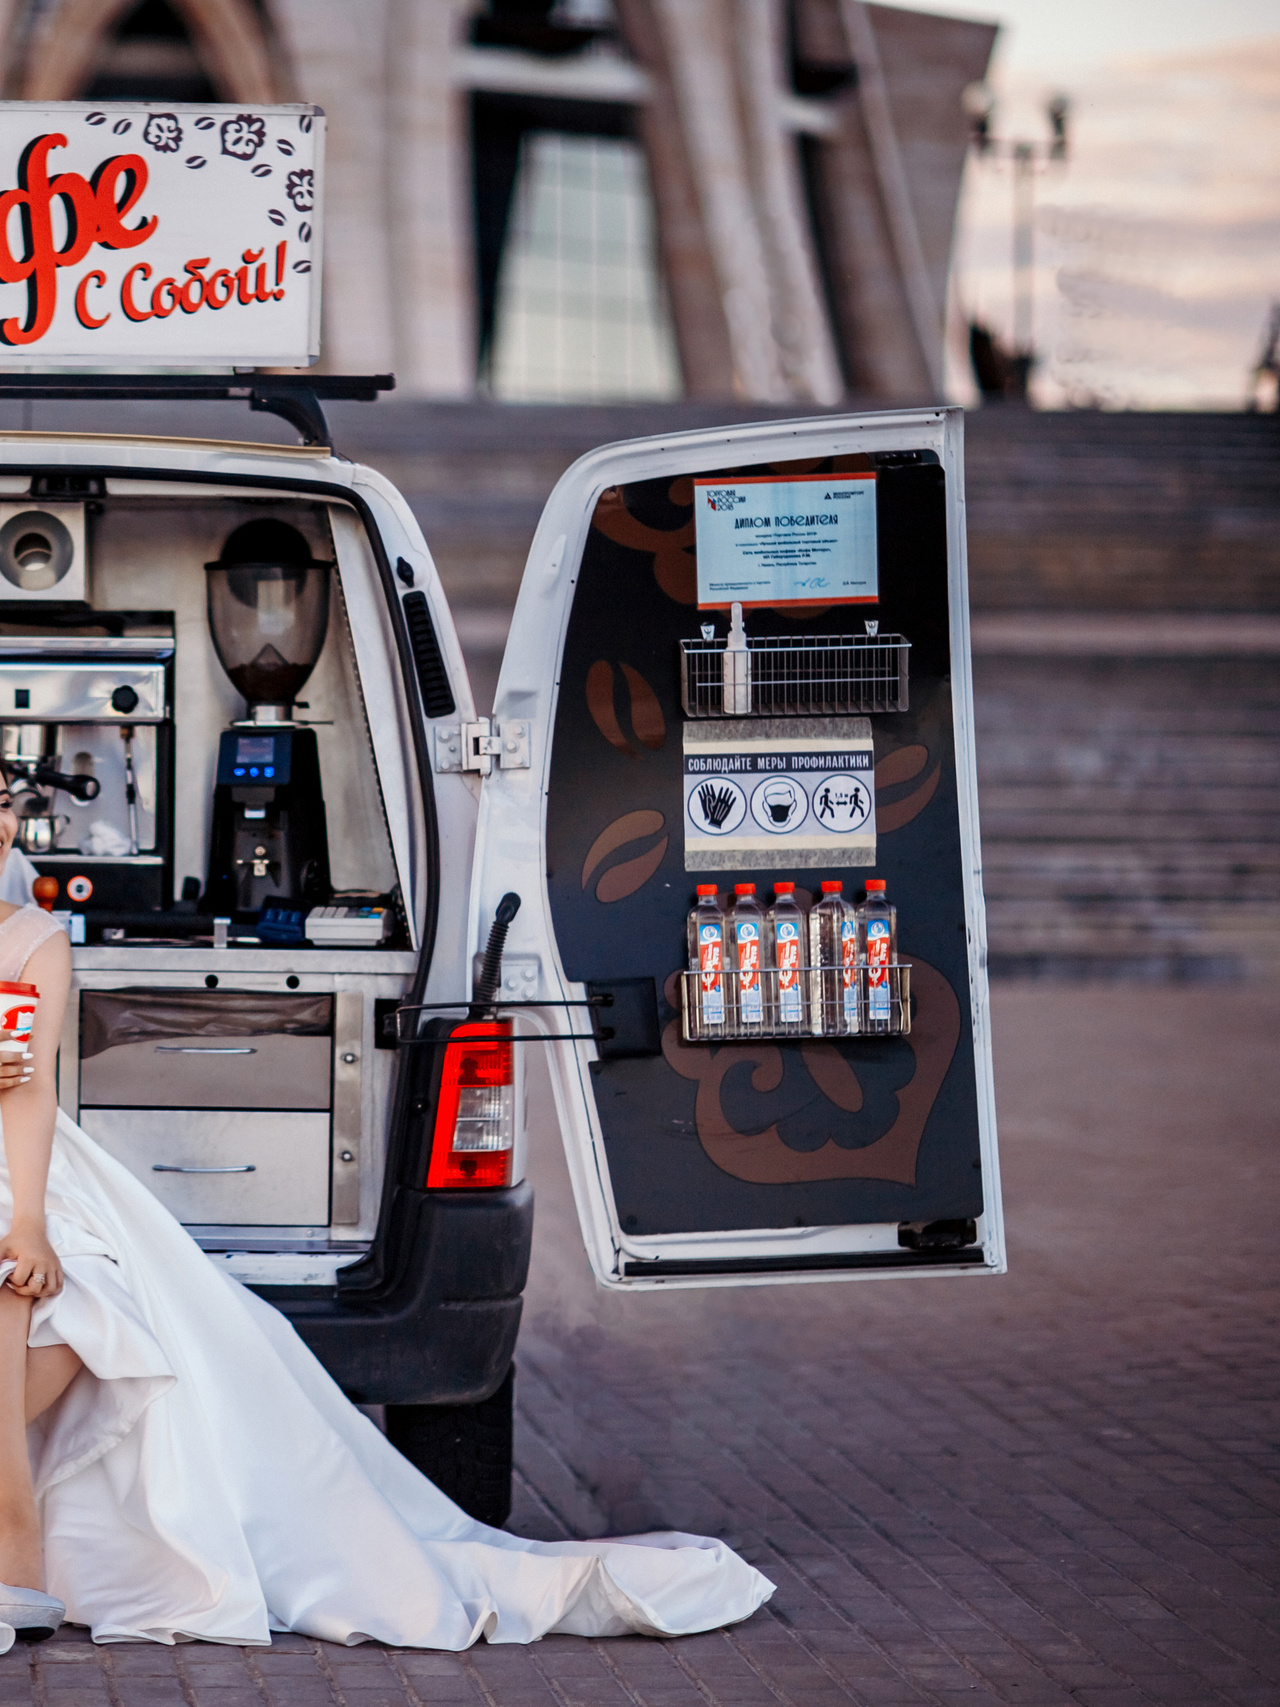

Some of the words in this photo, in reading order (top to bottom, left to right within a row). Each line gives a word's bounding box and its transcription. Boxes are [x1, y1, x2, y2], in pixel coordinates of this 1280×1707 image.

[119, 240, 287, 322] Собой!
[734, 517, 772, 530] ДИПЛОМ
[688, 755, 752, 773] СОБЛЮДАЙТЕ
[757, 756, 787, 770] МЕРЫ
[791, 754, 870, 769] ПРОФИЛАКТИКИ
